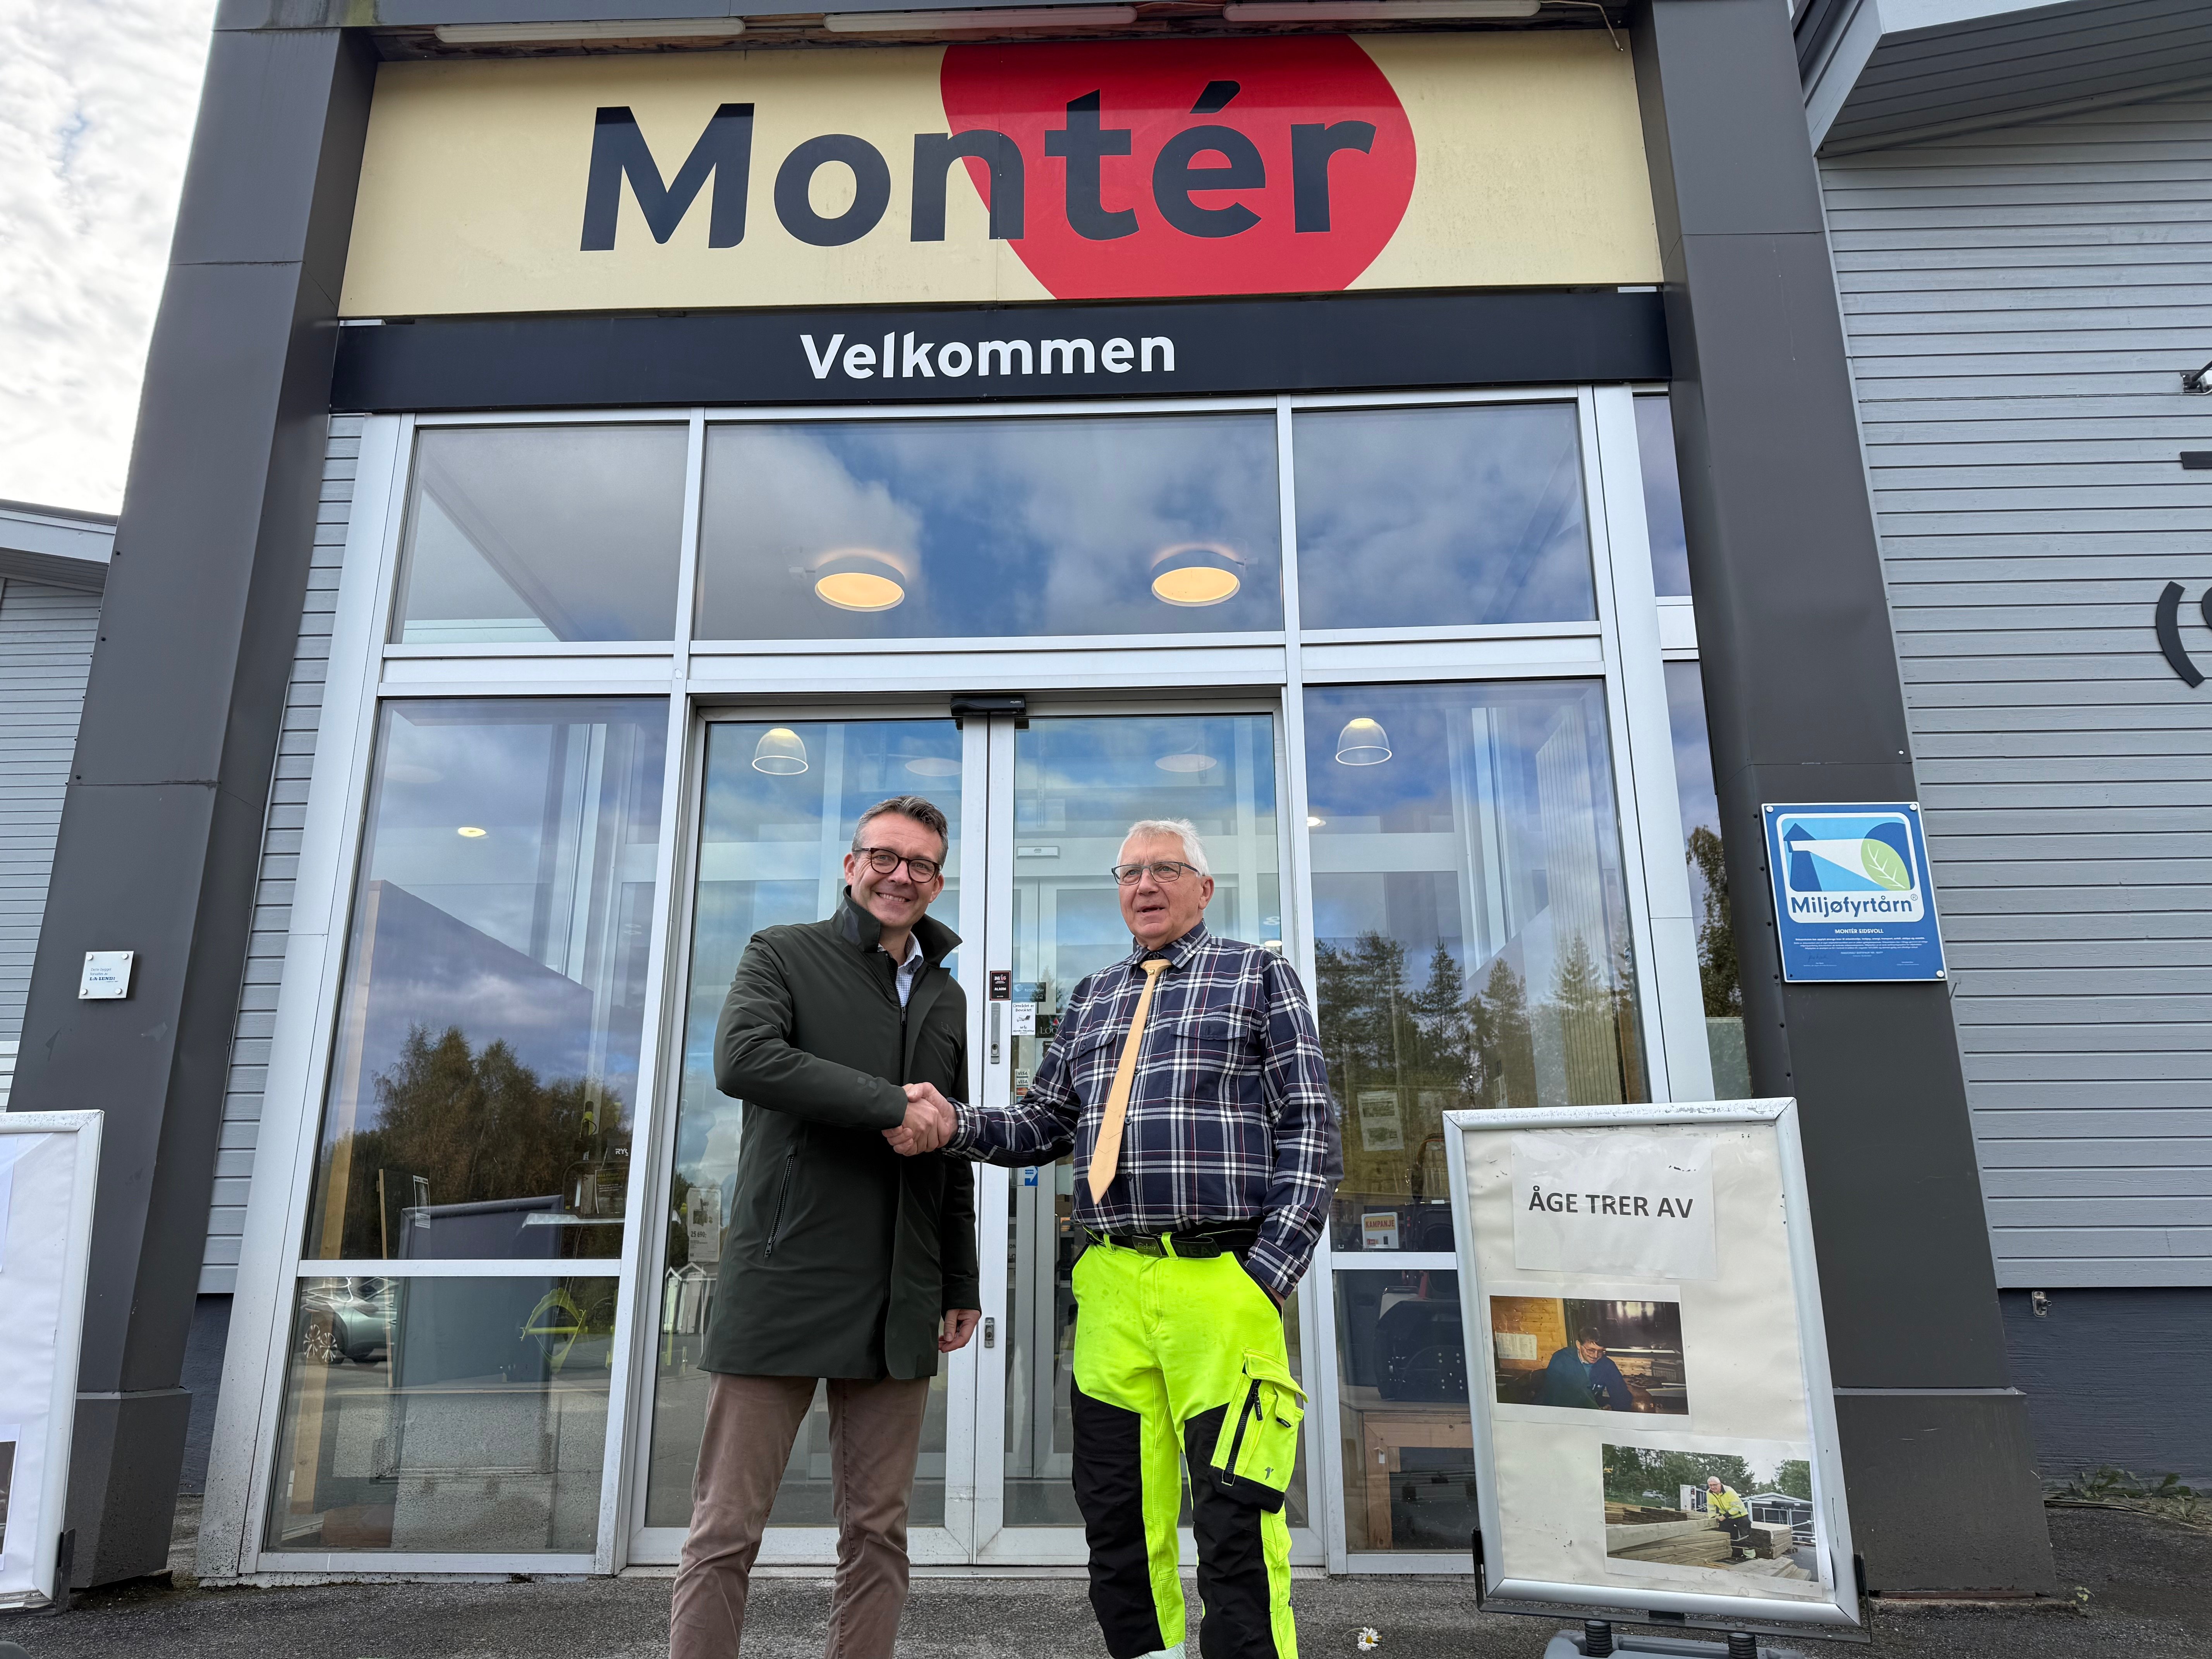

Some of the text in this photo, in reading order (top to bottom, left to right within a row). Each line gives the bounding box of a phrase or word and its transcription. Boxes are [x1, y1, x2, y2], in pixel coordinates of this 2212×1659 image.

[580, 80, 1377, 251] Montér
[800, 331, 1175, 379] Velkommen
[1528, 1185, 1693, 1218] ÅGE TRER AV
[1365, 1220, 1395, 1228] KAMPANJE
